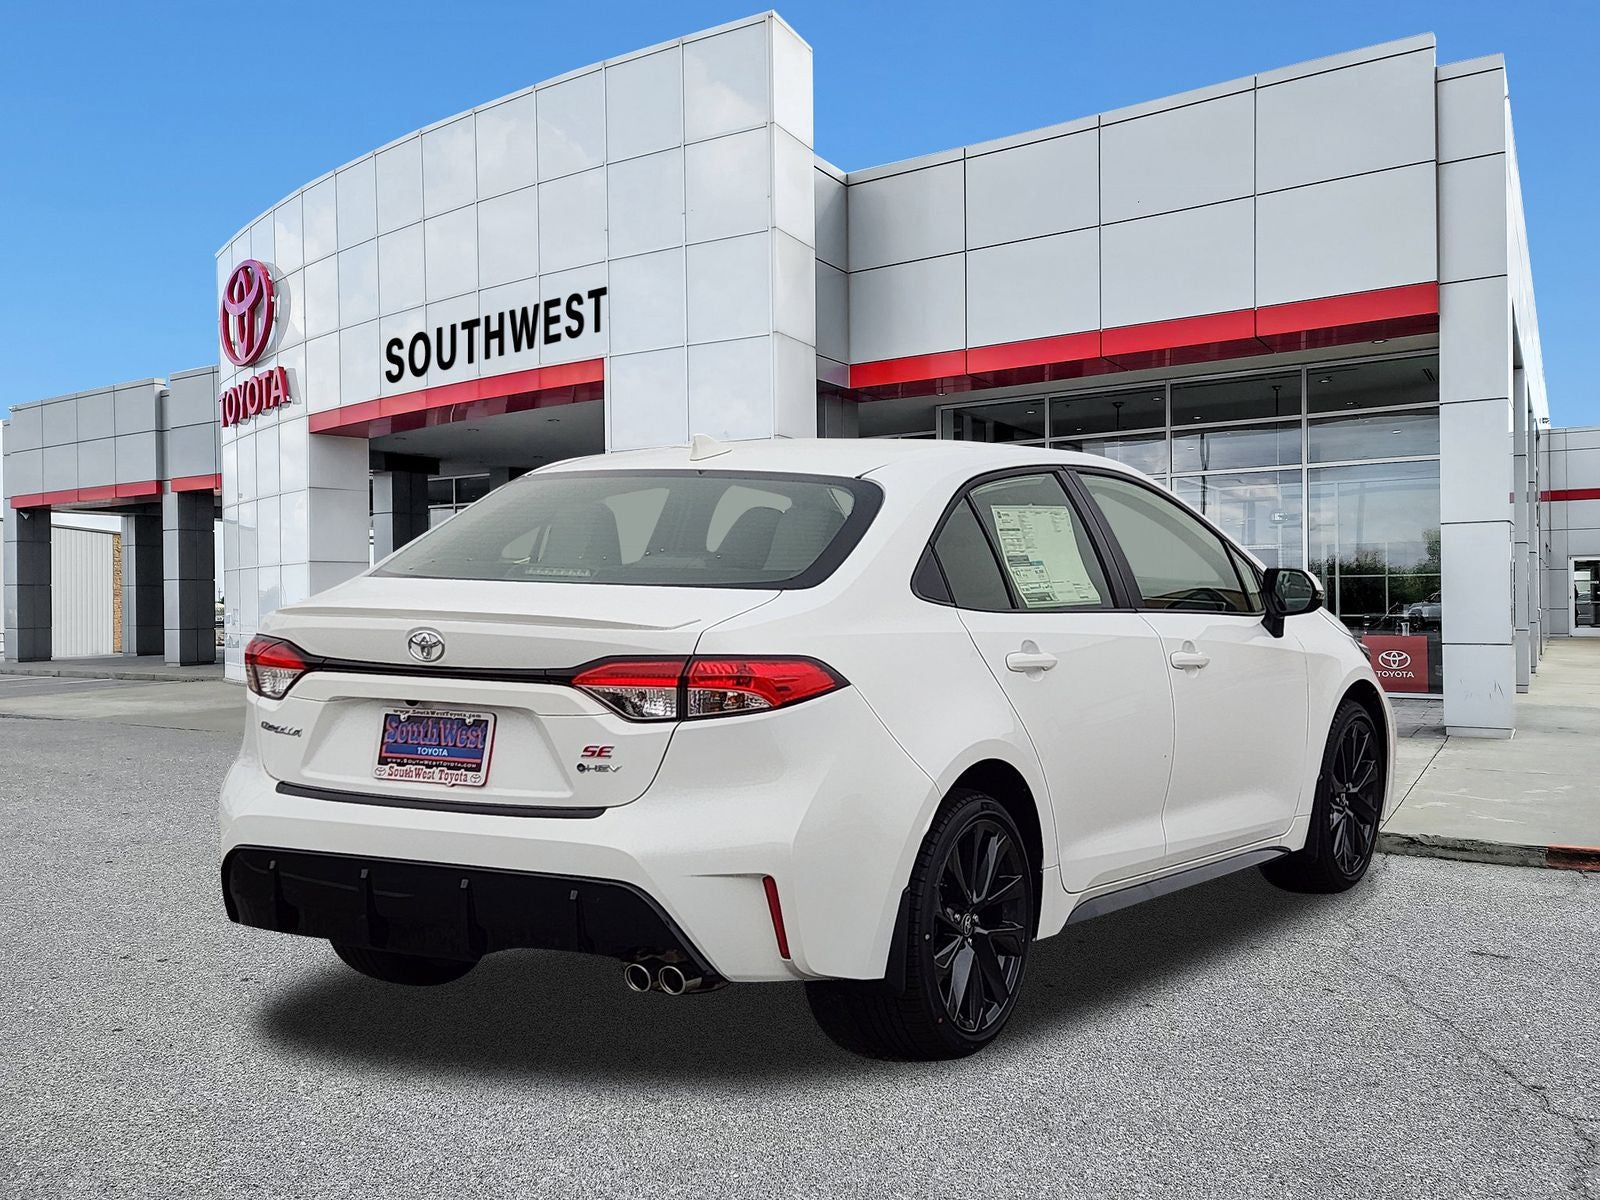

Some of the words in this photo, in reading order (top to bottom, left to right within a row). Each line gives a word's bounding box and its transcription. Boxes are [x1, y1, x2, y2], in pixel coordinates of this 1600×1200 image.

[385, 286, 607, 383] SOUTHWEST
[218, 366, 291, 427] TOYOTA
[1376, 670, 1414, 678] TOYOTA
[384, 715, 487, 749] SouthWest
[417, 747, 448, 756] TOYOTA
[581, 745, 615, 758] SE
[388, 765, 435, 780] SouthWest
[438, 769, 468, 784] Toyota
